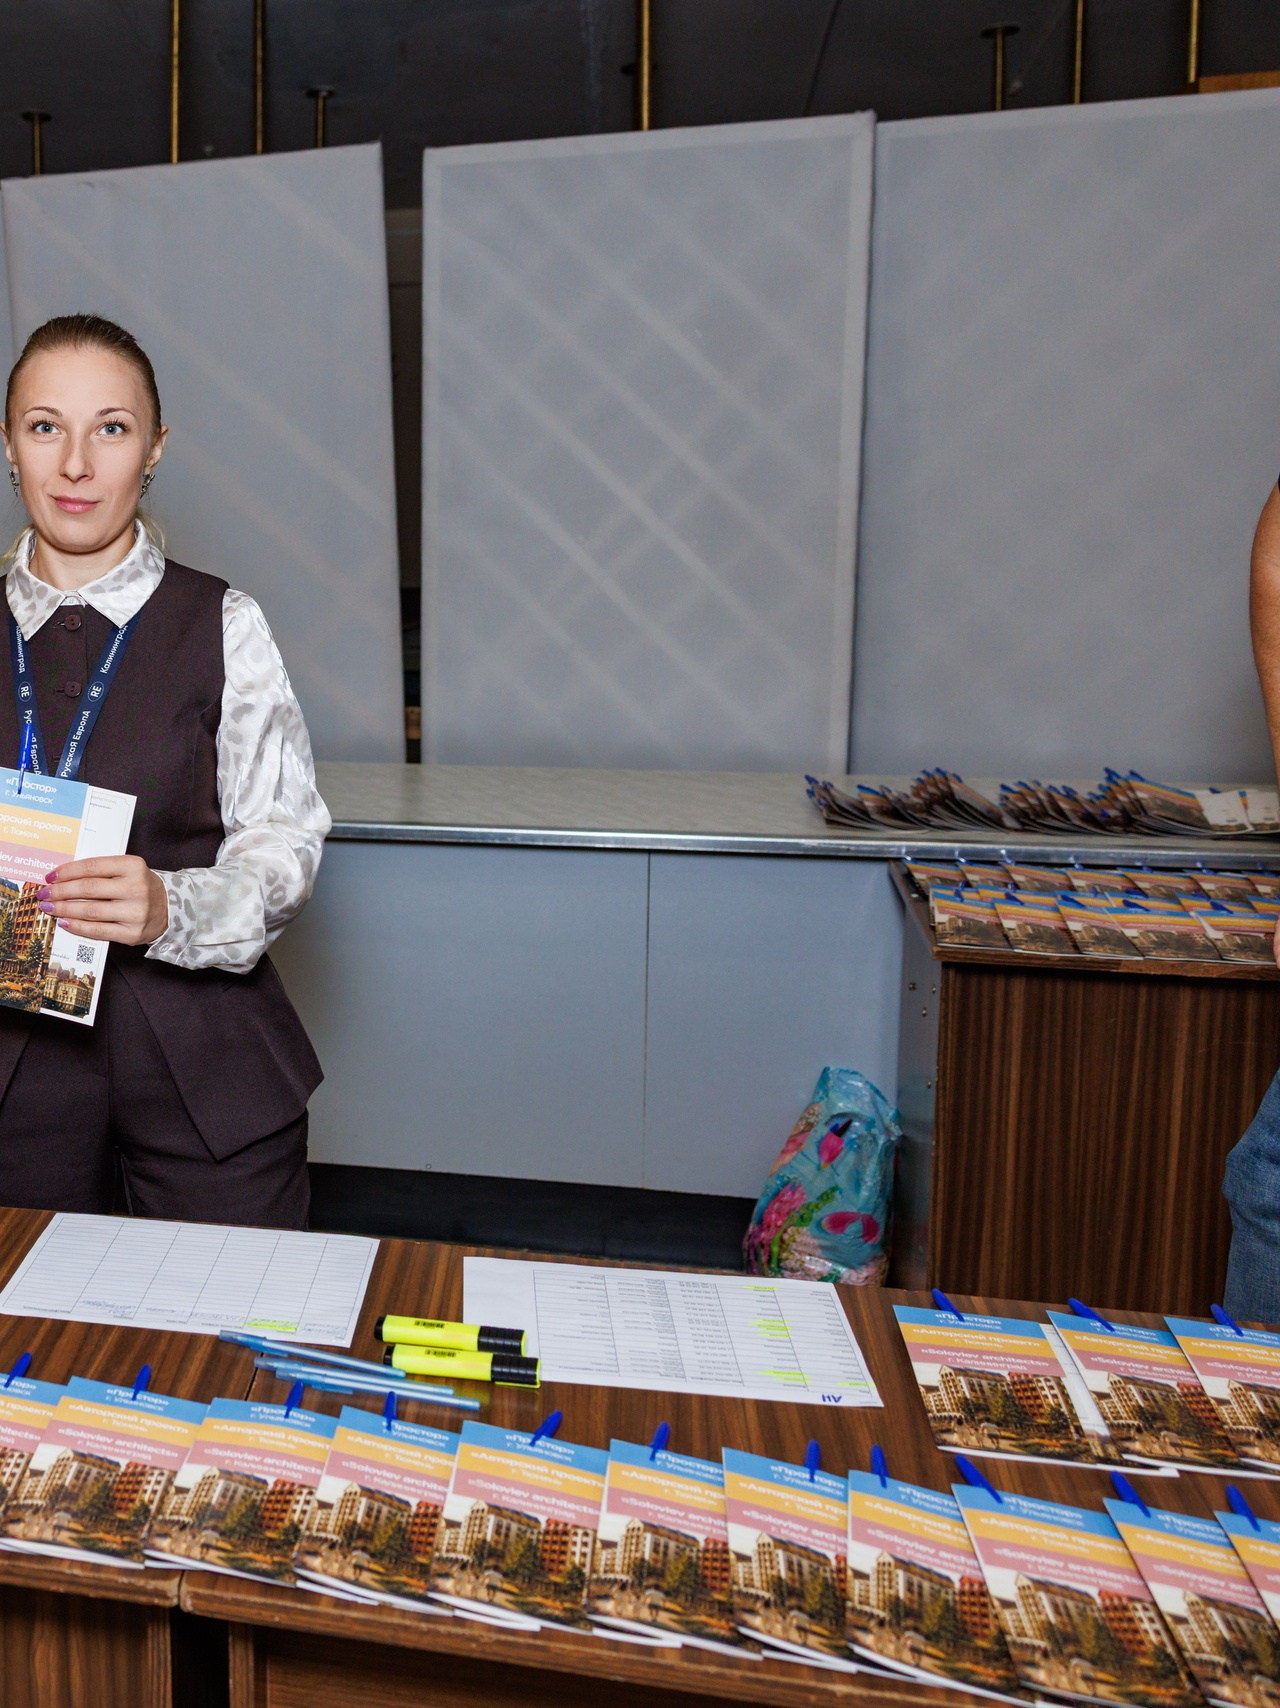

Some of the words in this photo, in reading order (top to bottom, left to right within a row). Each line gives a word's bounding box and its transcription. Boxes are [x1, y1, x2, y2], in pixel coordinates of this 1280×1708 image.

[20, 687, 29, 697] RE
[90, 686, 102, 697] RE
[6, 777, 57, 793] «Постор»
[12, 790, 53, 804] Ульяновск
[11, 827, 40, 839] Тюмень
[33, 819, 72, 834] проект»
[14, 856, 58, 870] architects
[948, 1320, 1002, 1330] Ульяновск
[913, 1329, 986, 1340] «Авторский
[989, 1336, 1040, 1347] проект»
[963, 1339, 1003, 1348] Тюмень
[1075, 1335, 1147, 1352] «Авторский
[1191, 1341, 1267, 1356] «Авторский
[921, 1348, 979, 1358] «Soloviev
[982, 1354, 1049, 1367] architects»
[956, 1358, 1027, 1371] Калининград
[1091, 1356, 1149, 1370] «Soloviev
[1207, 1362, 1267, 1375] «Soloviev
[6, 1403, 53, 1417] проект»
[69, 1404, 139, 1422] «Авторский
[140, 1418, 188, 1433] проект»
[112, 1420, 148, 1433] Тюмень
[213, 1424, 285, 1439] «Авторский
[58, 1428, 113, 1443] «Soloviev
[115, 1439, 178, 1457] architects»
[259, 1437, 296, 1449] Тюмень
[347, 1435, 421, 1458] «Авторский
[86, 1441, 152, 1461] Калининград
[204, 1448, 261, 1462] «Soloviev
[264, 1457, 323, 1475] architects
[395, 1455, 434, 1470] Тюмень
[471, 1452, 549, 1474] «Авторский
[234, 1460, 302, 1480] Калининград
[342, 1460, 401, 1481] «Soloviev
[523, 1470, 562, 1486] Тюмень
[771, 1464, 845, 1489] «Просор»
[468, 1478, 529, 1498] «Soloviev
[622, 1470, 702, 1494] «Авторский
[739, 1482, 822, 1509] «Авторский
[621, 1497, 685, 1517] «Soloviev
[742, 1510, 808, 1533] «Soloviev
[865, 1501, 952, 1531] «Авторский
[867, 1528, 935, 1554] «Soloviev
